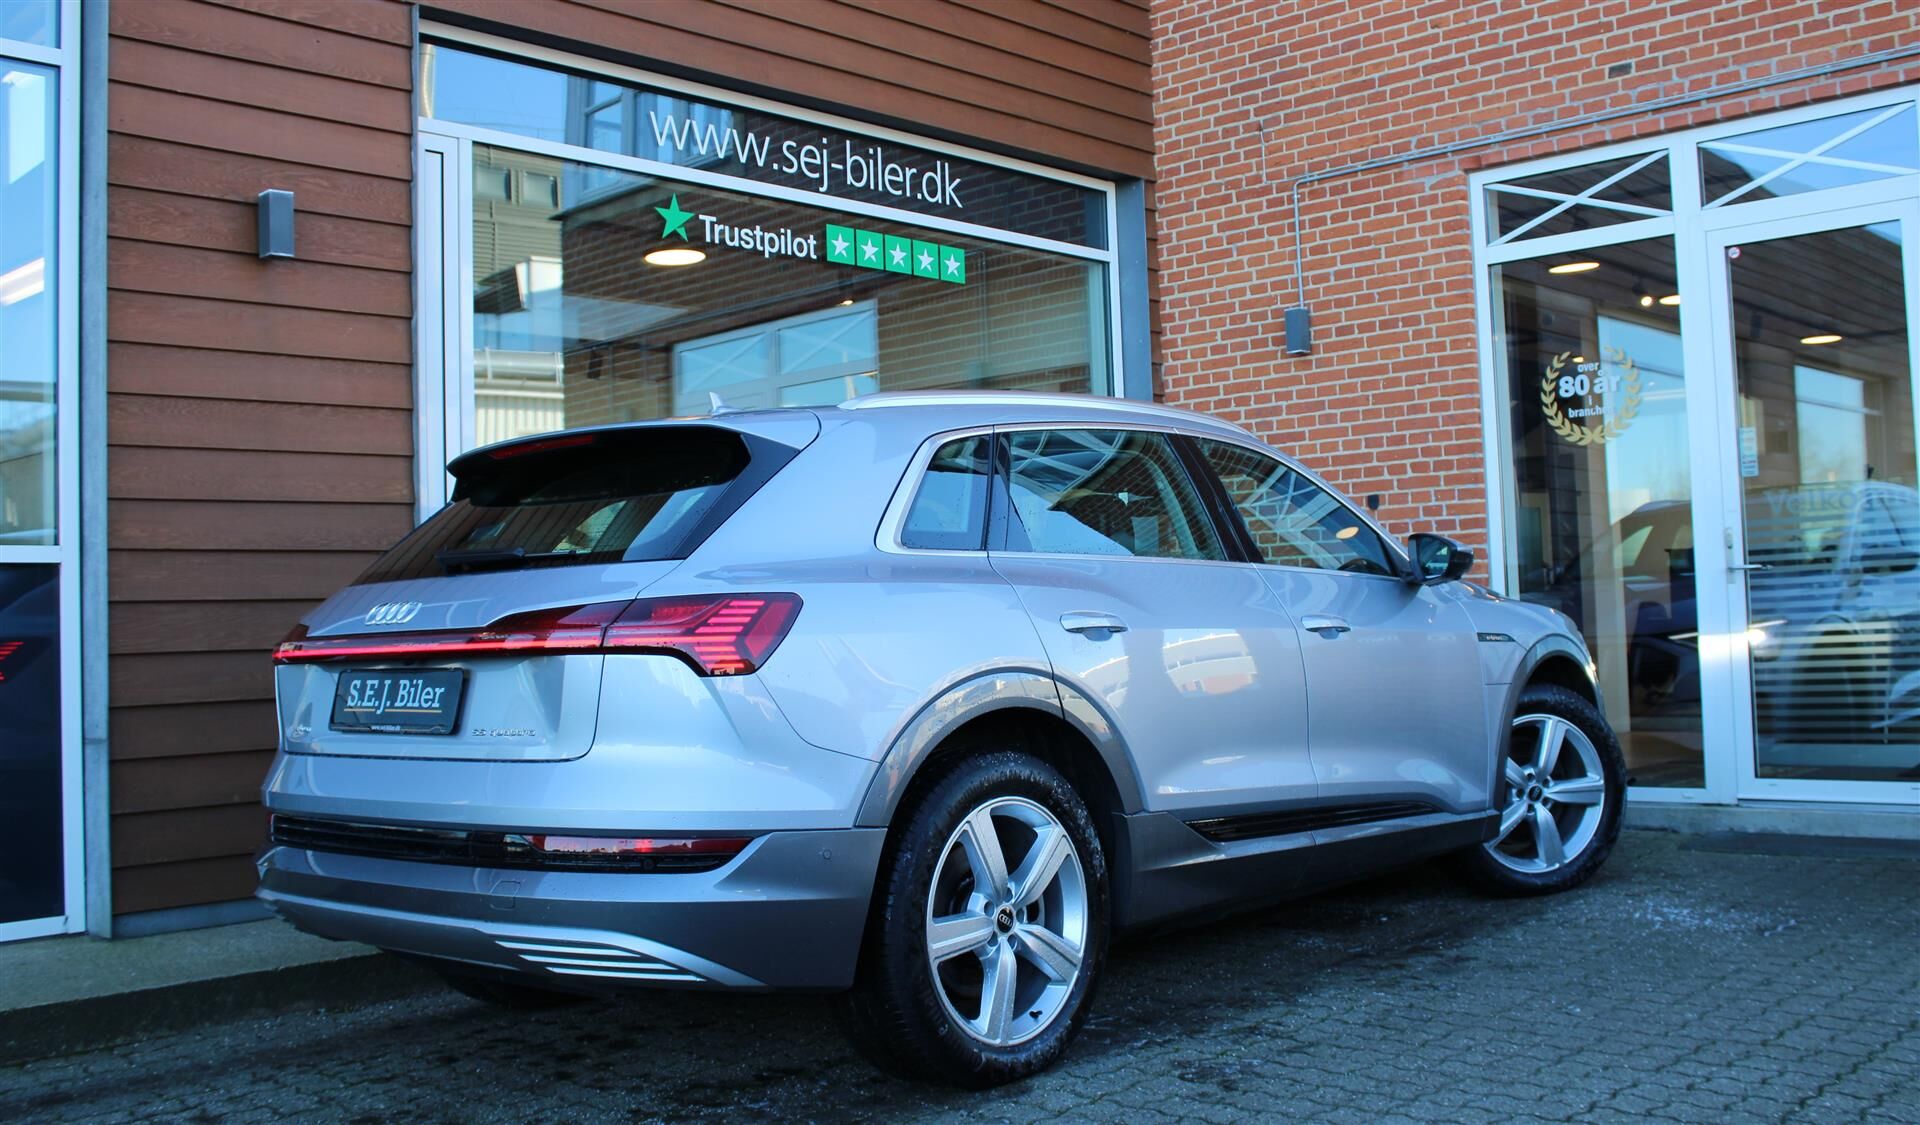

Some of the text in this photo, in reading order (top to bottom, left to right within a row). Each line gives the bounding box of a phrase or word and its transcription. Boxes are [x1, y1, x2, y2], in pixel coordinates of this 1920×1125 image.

[650, 111, 963, 208] www.sej-biler.dk
[699, 214, 817, 260] Trustpilot
[1559, 370, 1621, 398] 80 år
[1577, 362, 1600, 373] over
[347, 679, 445, 714] S.E.J. Biler
